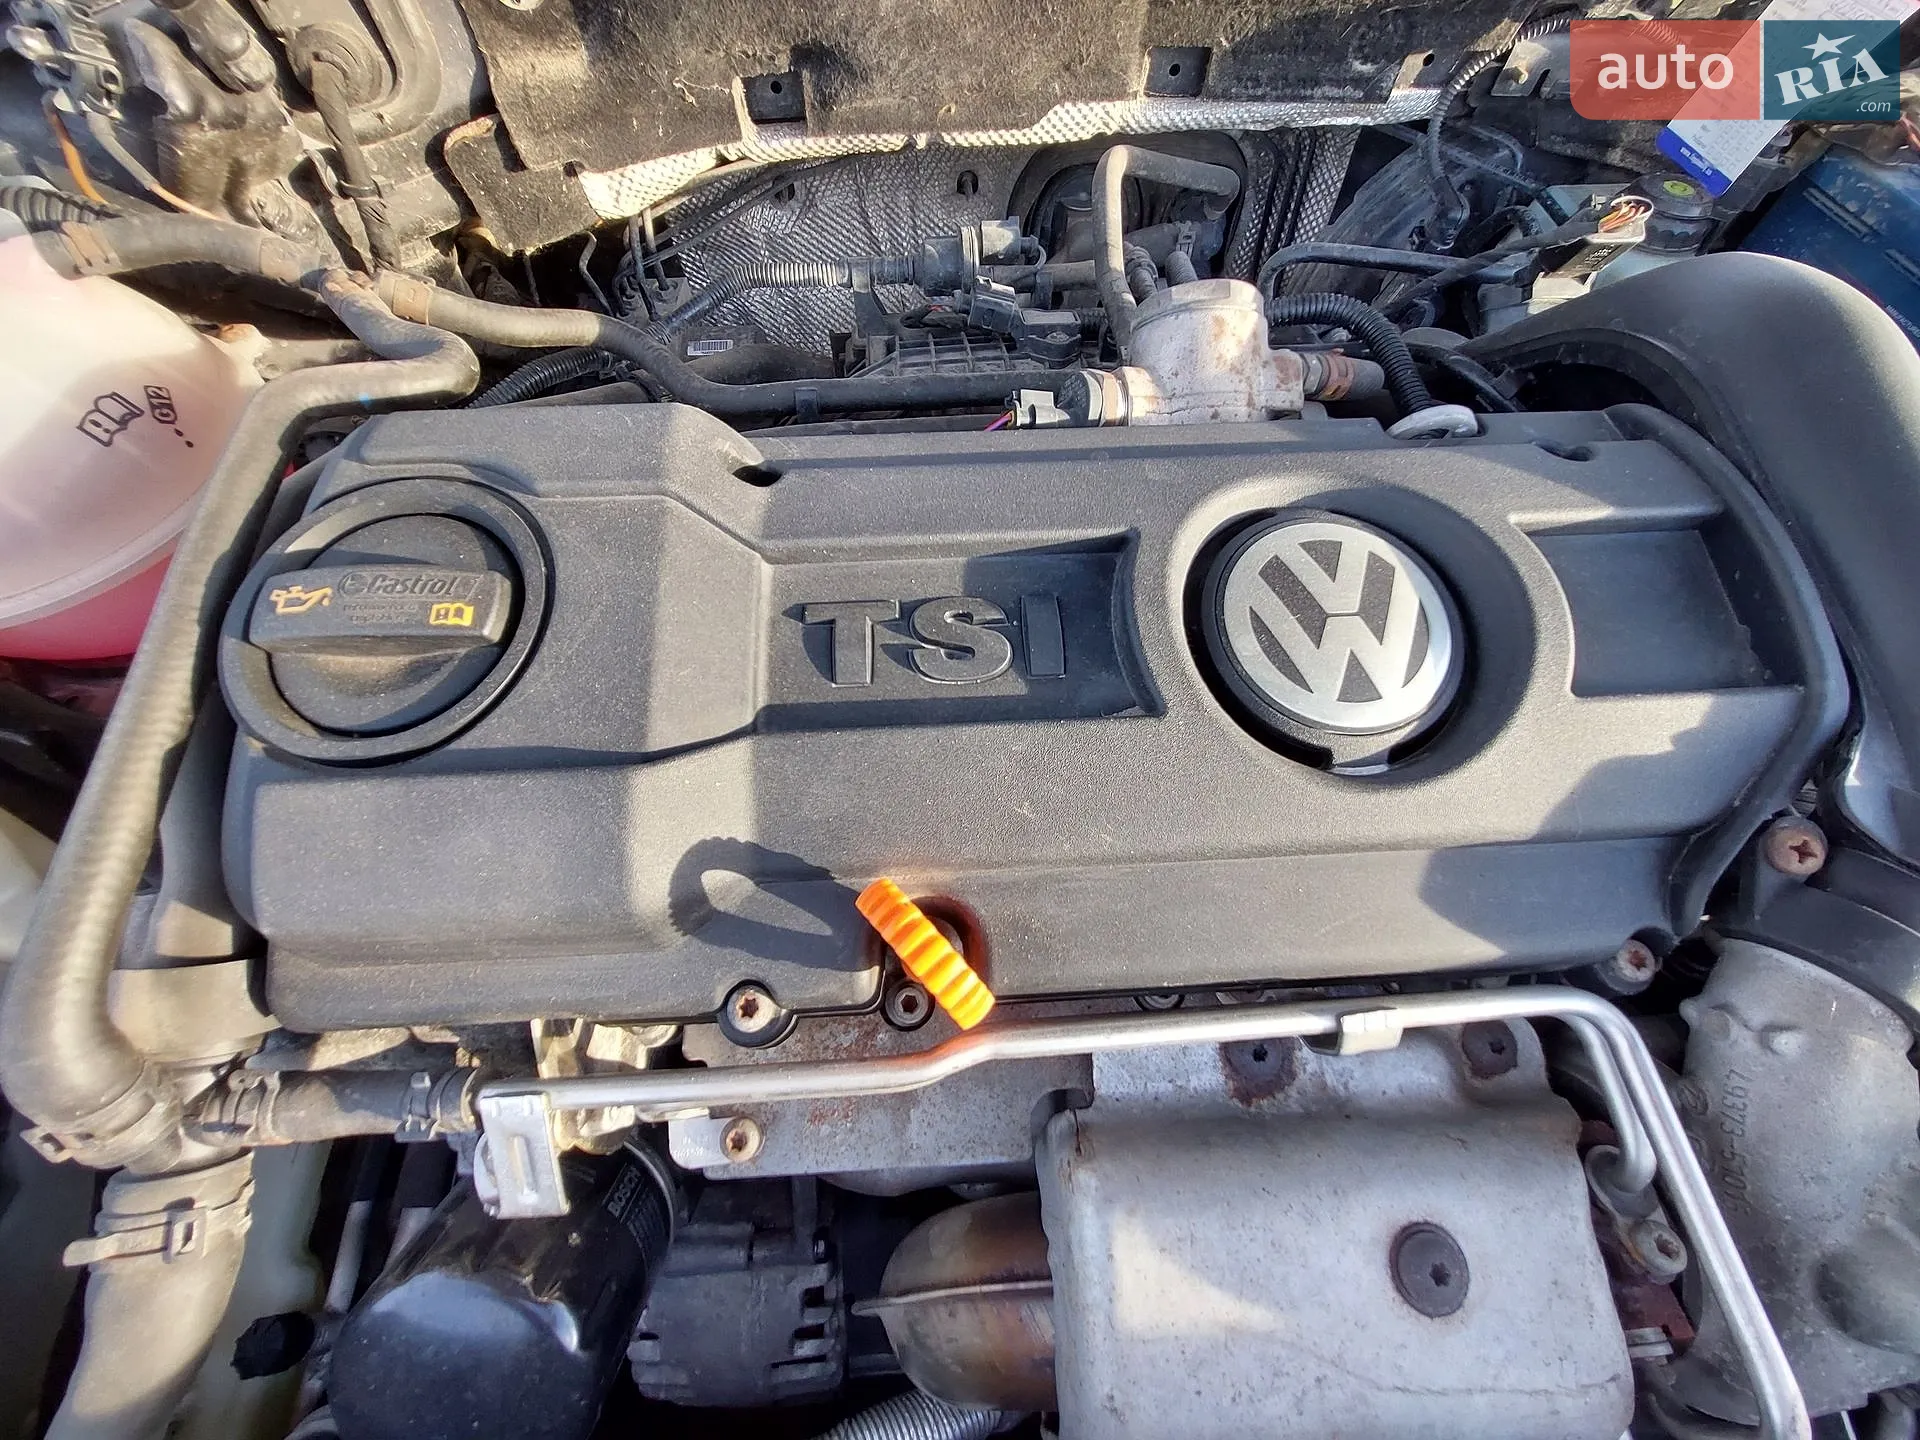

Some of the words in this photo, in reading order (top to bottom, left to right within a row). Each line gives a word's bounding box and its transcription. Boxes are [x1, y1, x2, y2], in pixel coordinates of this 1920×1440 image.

[145, 386, 177, 424] G12
[366, 573, 459, 597] Castrol
[803, 592, 1066, 688] TSI
[606, 1166, 642, 1218] BOSCH
